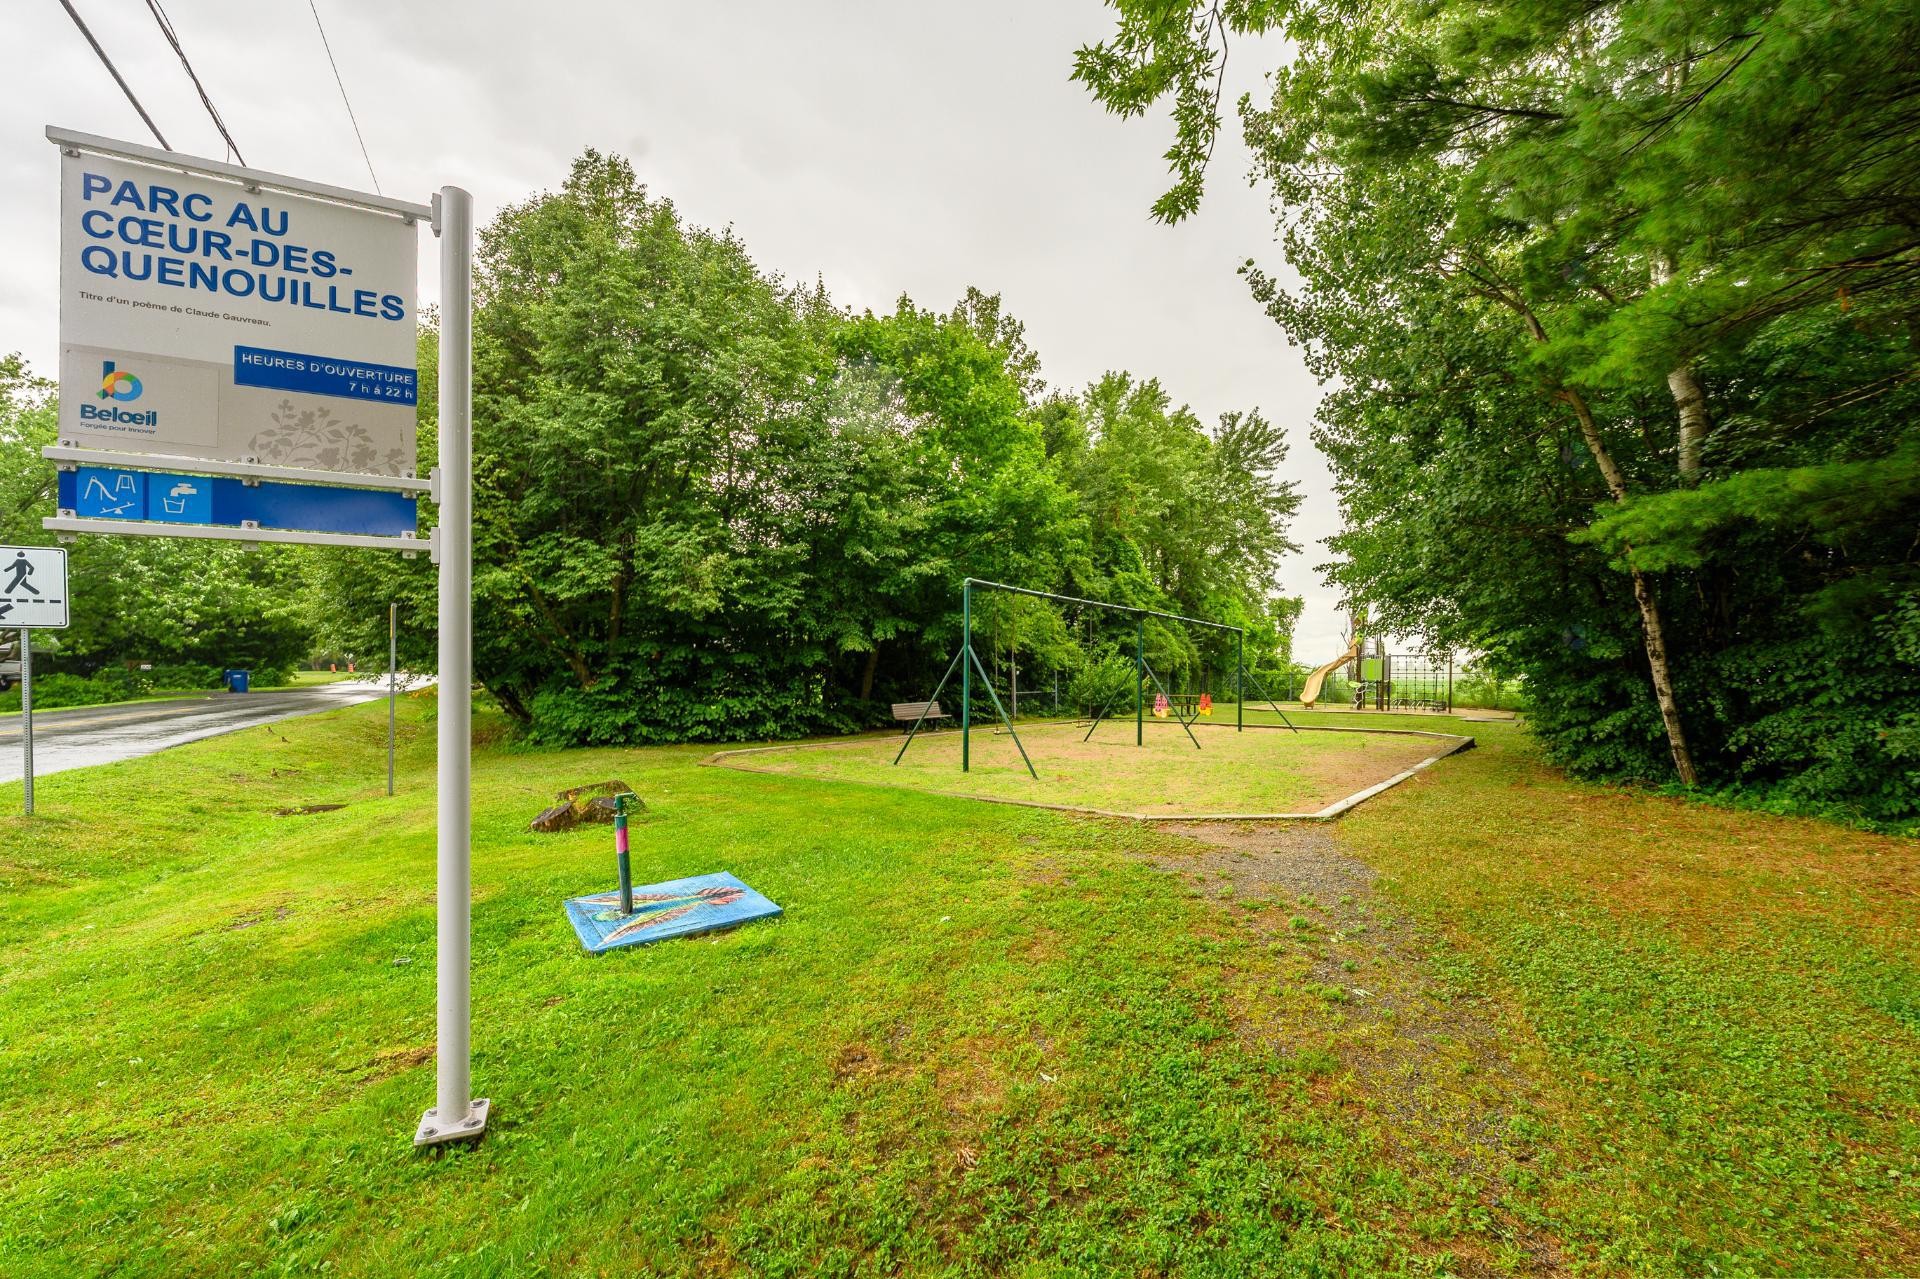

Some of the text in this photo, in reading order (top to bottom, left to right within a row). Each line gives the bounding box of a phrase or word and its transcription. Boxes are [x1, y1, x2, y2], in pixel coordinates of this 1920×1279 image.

[83, 172, 289, 237] PARC AU
[81, 210, 353, 278] CŒUR-DES-
[81, 245, 405, 321] QUENOUILLES
[79, 291, 272, 327] Titre d'un poème de Claude Gauvreau.
[242, 353, 413, 385] HEURES D'OUVERTURE
[349, 382, 356, 392] 7
[361, 384, 369, 393] h
[386, 387, 401, 398] 22
[405, 388, 413, 399] h
